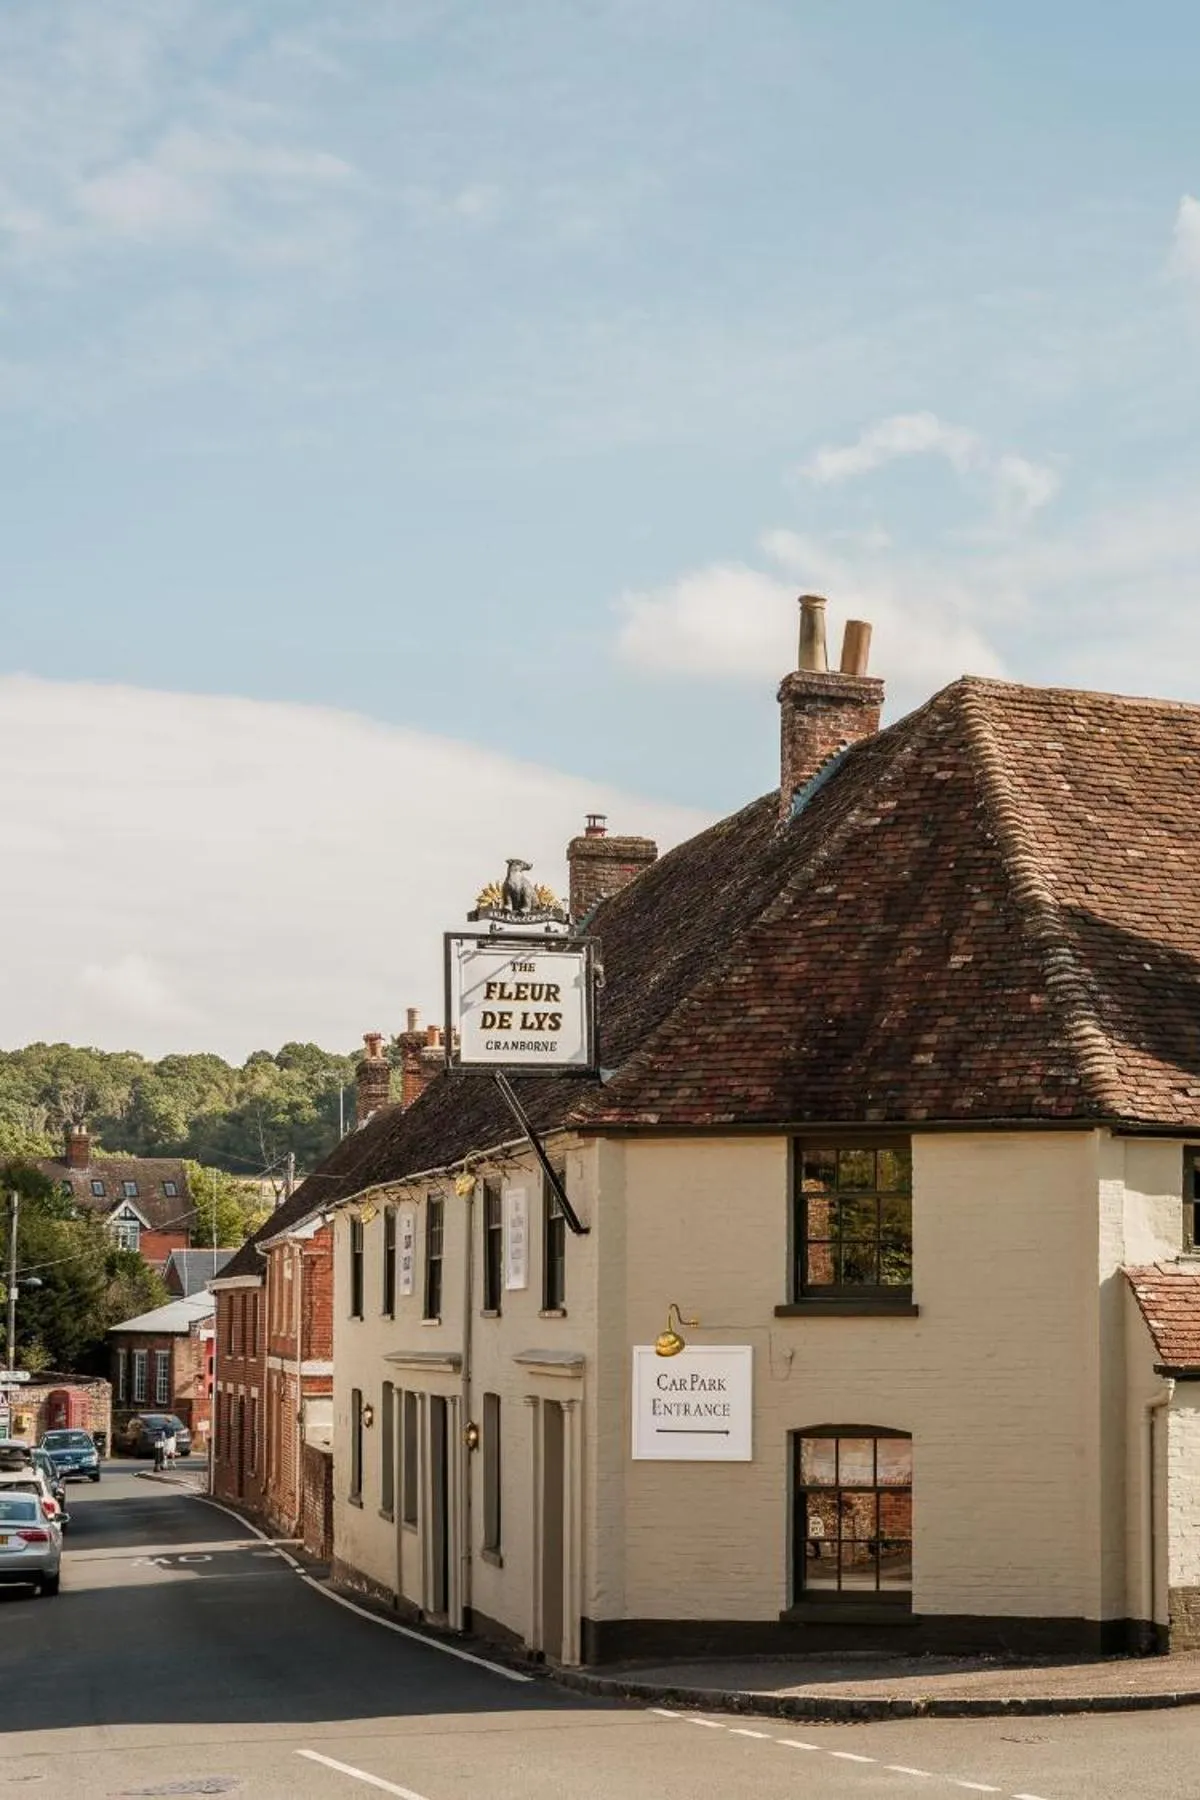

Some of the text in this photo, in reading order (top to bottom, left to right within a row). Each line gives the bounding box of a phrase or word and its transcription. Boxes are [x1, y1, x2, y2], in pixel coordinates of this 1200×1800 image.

[511, 962, 536, 972] THE
[484, 982, 561, 1002] FLEUR
[480, 1011, 563, 1031] DE LYS
[486, 1040, 558, 1052] CRANBORNE
